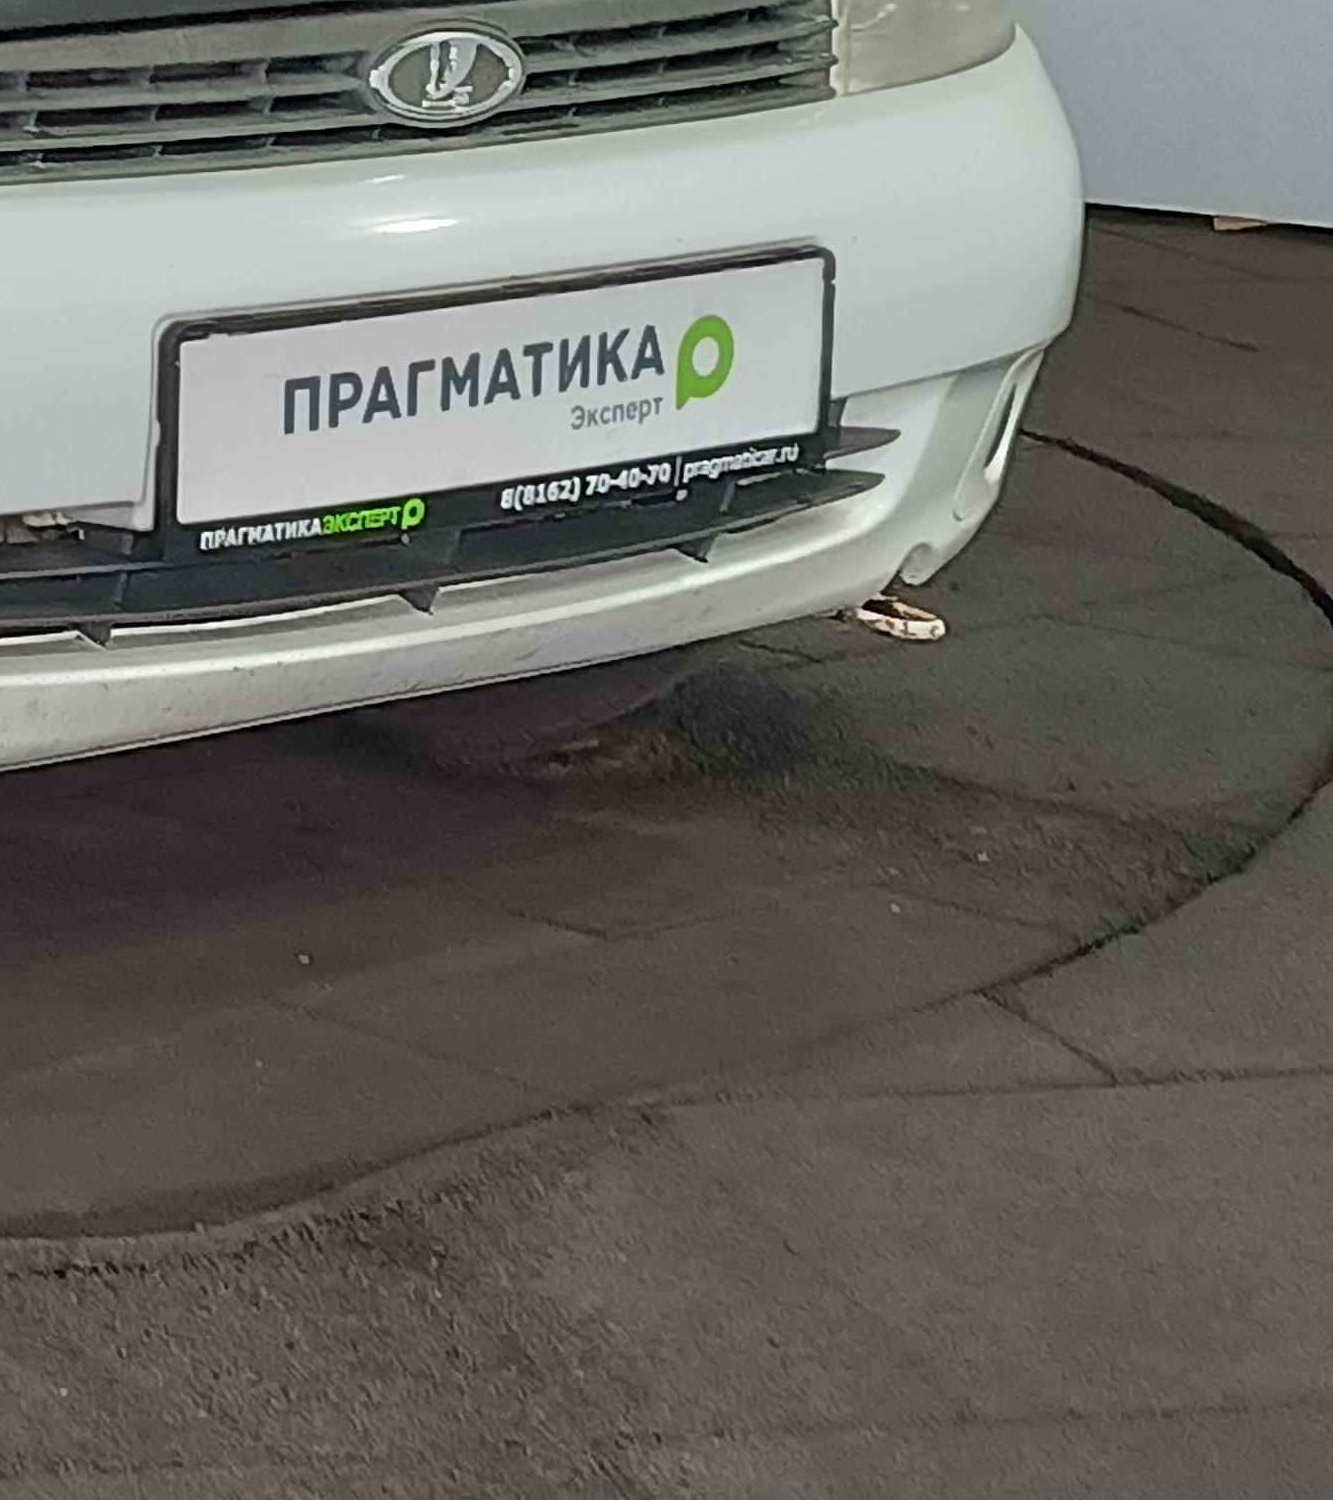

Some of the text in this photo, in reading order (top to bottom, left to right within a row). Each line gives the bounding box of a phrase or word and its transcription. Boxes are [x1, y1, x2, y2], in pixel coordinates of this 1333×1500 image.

[284, 325, 664, 434] ПРАГМАТИКА
[570, 396, 664, 430] Эксперт
[500, 476, 581, 511] 8(8162)
[585, 462, 672, 496] 70-40-70
